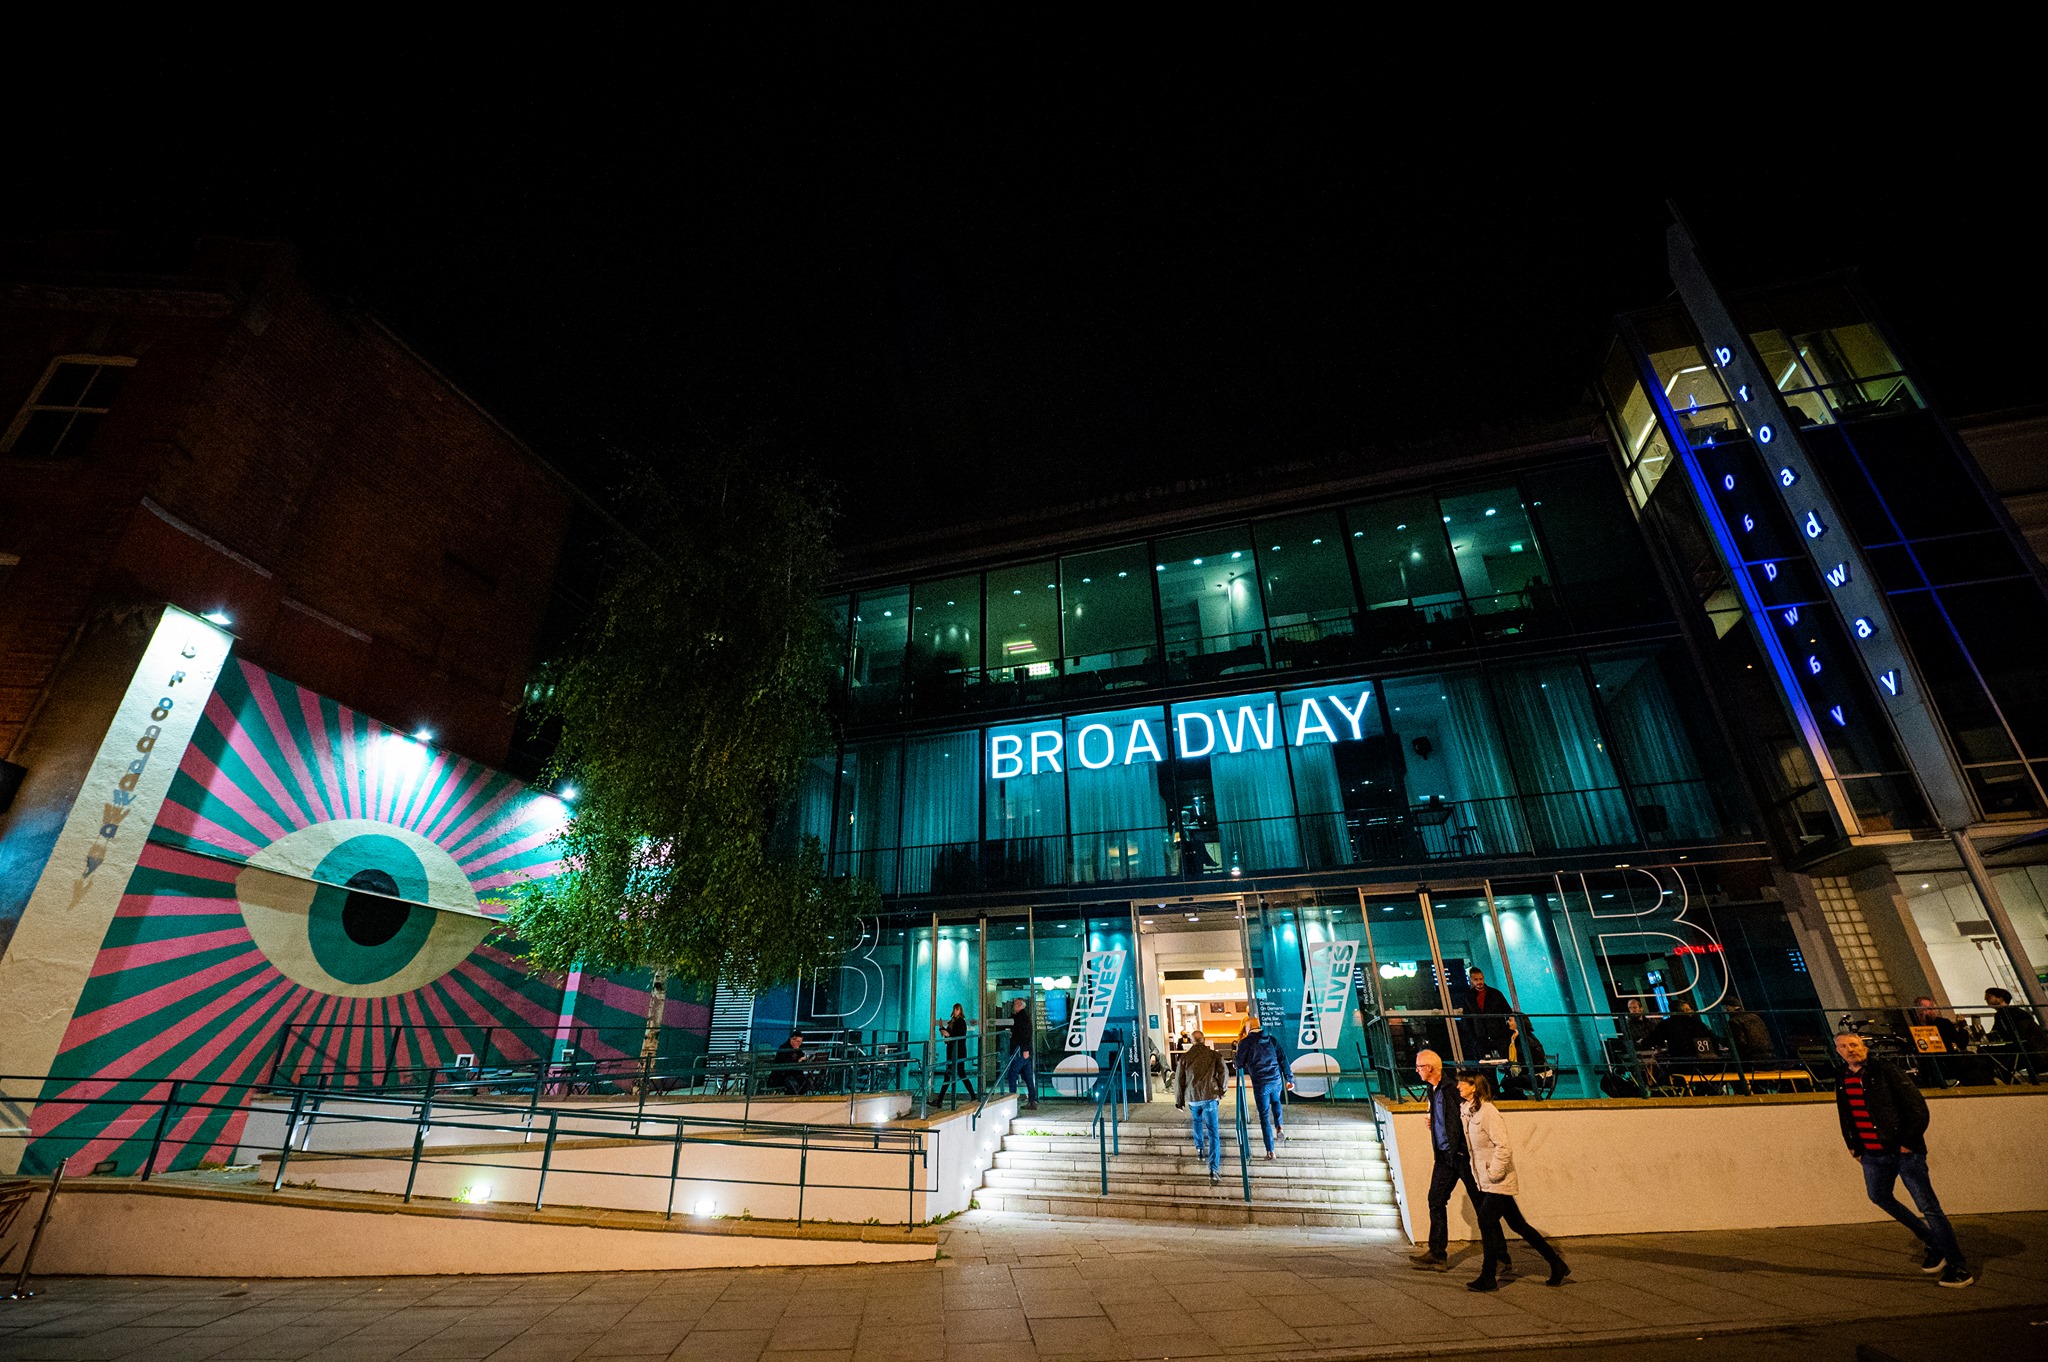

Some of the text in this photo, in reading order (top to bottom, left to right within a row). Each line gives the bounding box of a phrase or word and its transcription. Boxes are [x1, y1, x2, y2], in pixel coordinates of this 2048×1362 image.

[1716, 347, 1896, 695] broadway
[991, 691, 1370, 779] BROADWAY
[1069, 955, 1104, 1048] CINEMA
[1091, 954, 1120, 1018] LIVES
[1301, 945, 1333, 1046] CINEMA
[1325, 944, 1354, 1013] LIVES
[1696, 1040, 1710, 1052] 89
